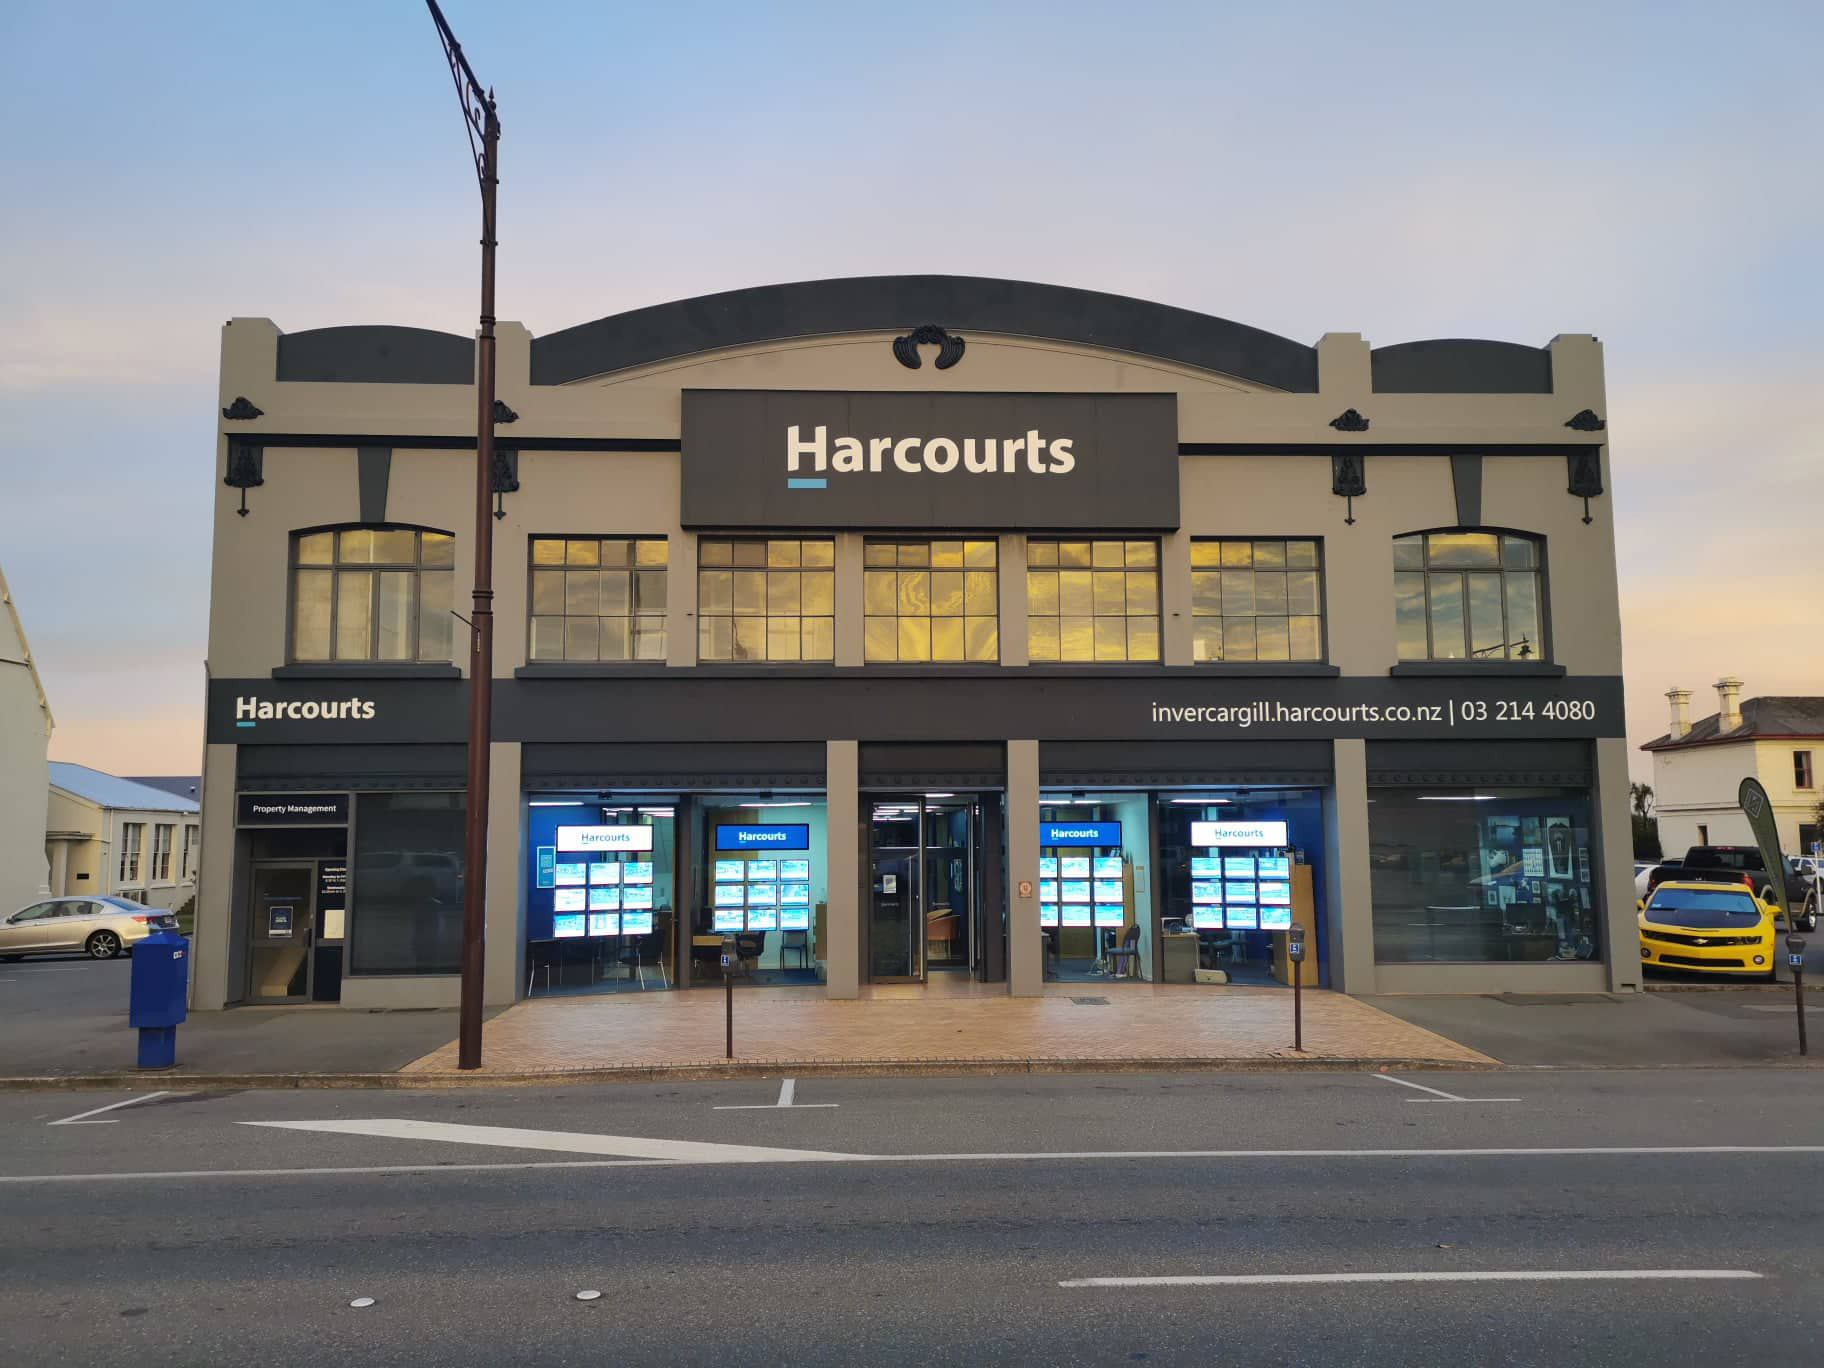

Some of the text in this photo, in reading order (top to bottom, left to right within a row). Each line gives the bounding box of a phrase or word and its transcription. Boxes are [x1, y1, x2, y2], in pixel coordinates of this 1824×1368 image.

[787, 425, 1076, 474] Harcourts
[236, 696, 376, 720] Harcourts
[1152, 701, 1443, 728] invercargill.harcourts.co.nz
[1461, 701, 1488, 721] 03
[1495, 700, 1536, 721] 214
[1541, 700, 1596, 720] 4080
[253, 804, 336, 815] Property Management
[581, 833, 631, 842] Harcourts
[738, 831, 787, 841] Harcourts
[1051, 828, 1099, 838] Harcourts
[1215, 828, 1264, 838] Harcourts
